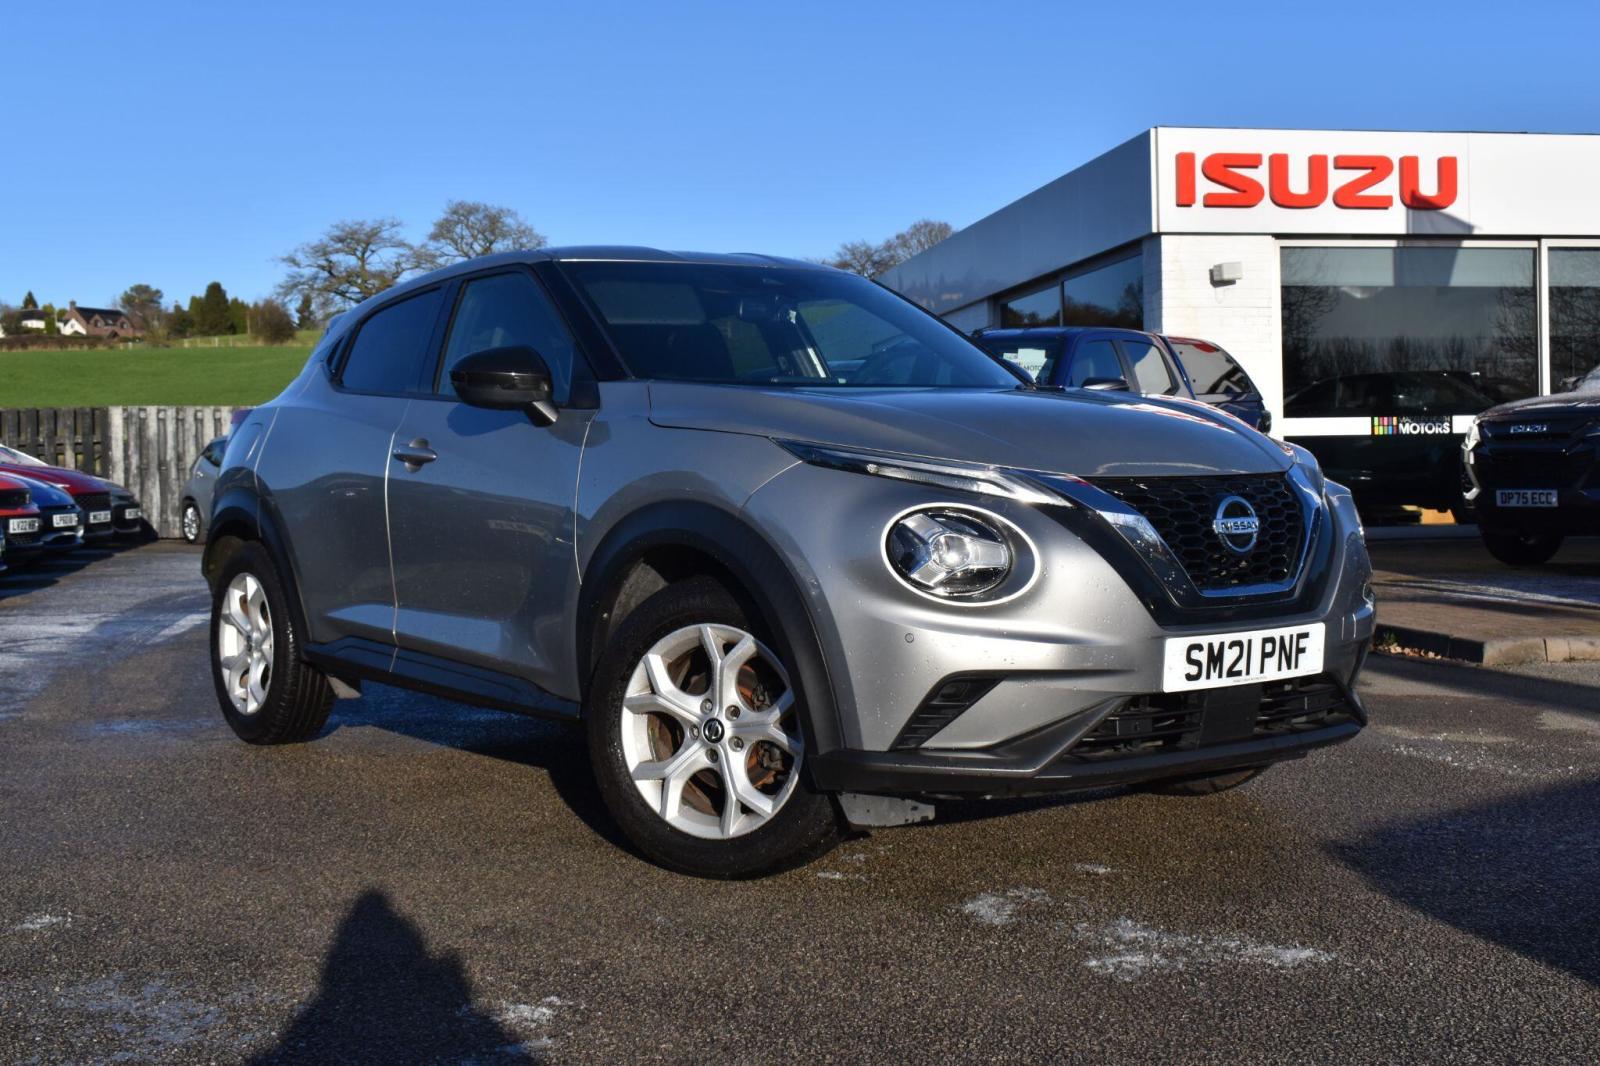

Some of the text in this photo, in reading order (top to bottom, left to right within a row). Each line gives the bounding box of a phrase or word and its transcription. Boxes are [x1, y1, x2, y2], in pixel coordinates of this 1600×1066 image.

[1175, 152, 1457, 209] ISUZU
[1399, 422, 1450, 434] MOTORS
[1500, 491, 1529, 505] DP75
[1220, 521, 1258, 531] NISSAN
[1184, 632, 1310, 682] SM21 PNF
